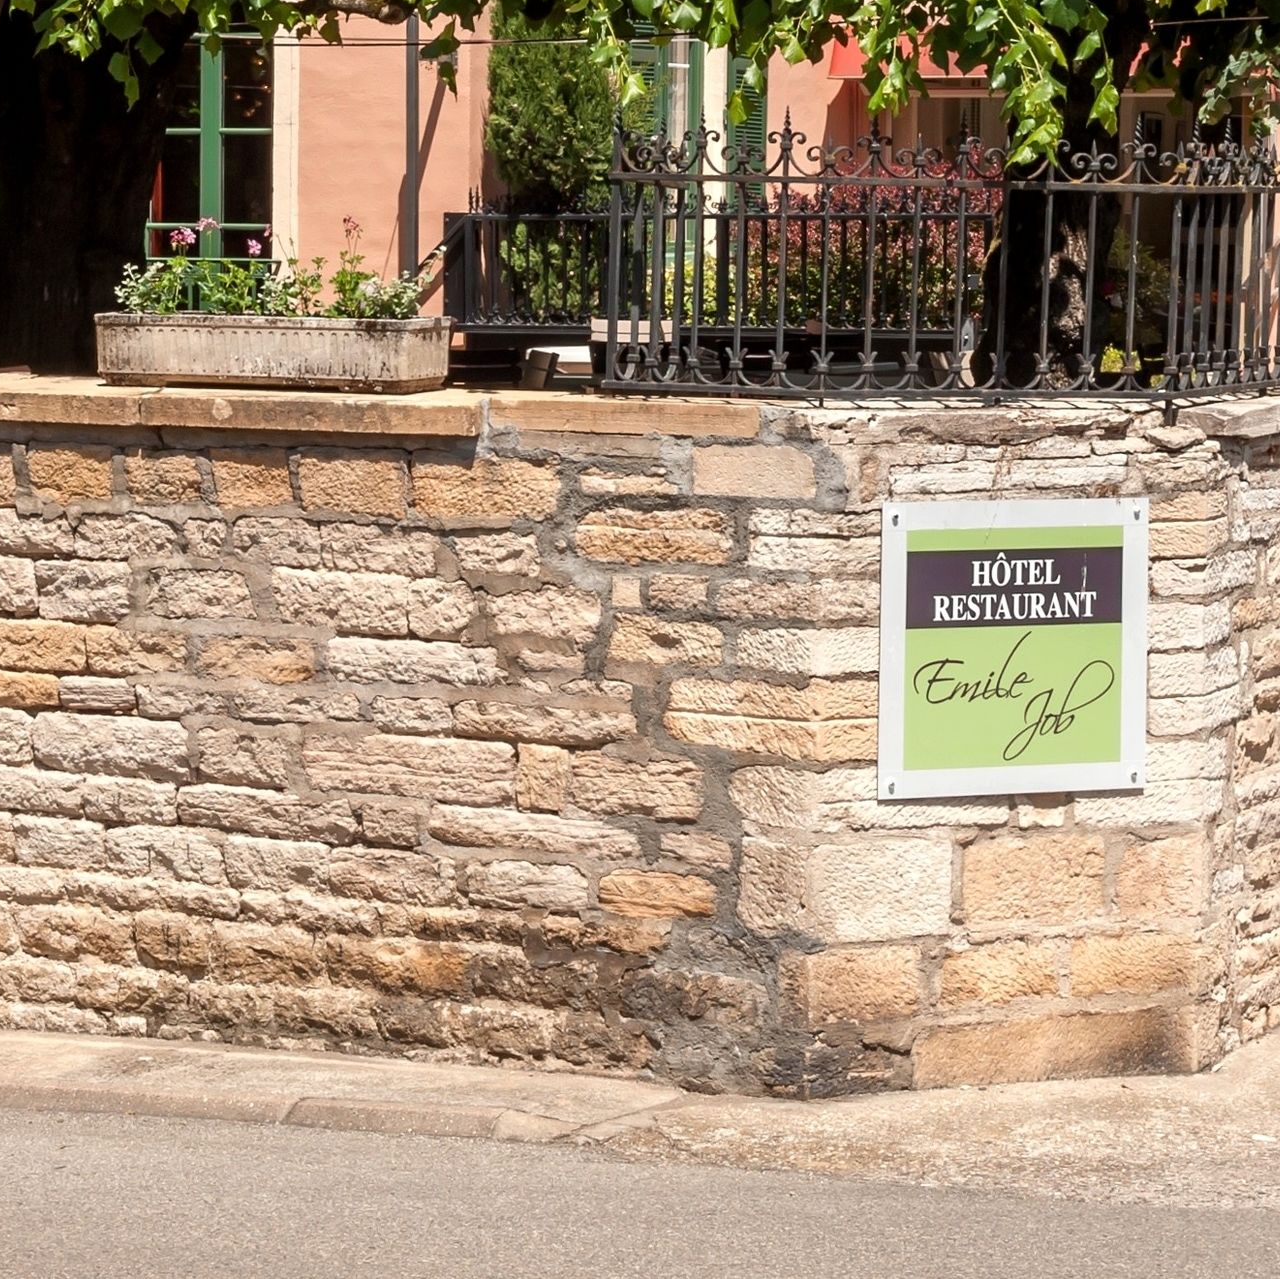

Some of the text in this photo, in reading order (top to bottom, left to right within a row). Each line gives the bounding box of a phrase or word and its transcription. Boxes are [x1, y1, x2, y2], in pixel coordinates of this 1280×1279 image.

[971, 552, 1060, 587] HÔTEL
[932, 591, 1096, 622] RESTAURANT
[913, 631, 1033, 704] Emile
[1003, 660, 1114, 761] Job
